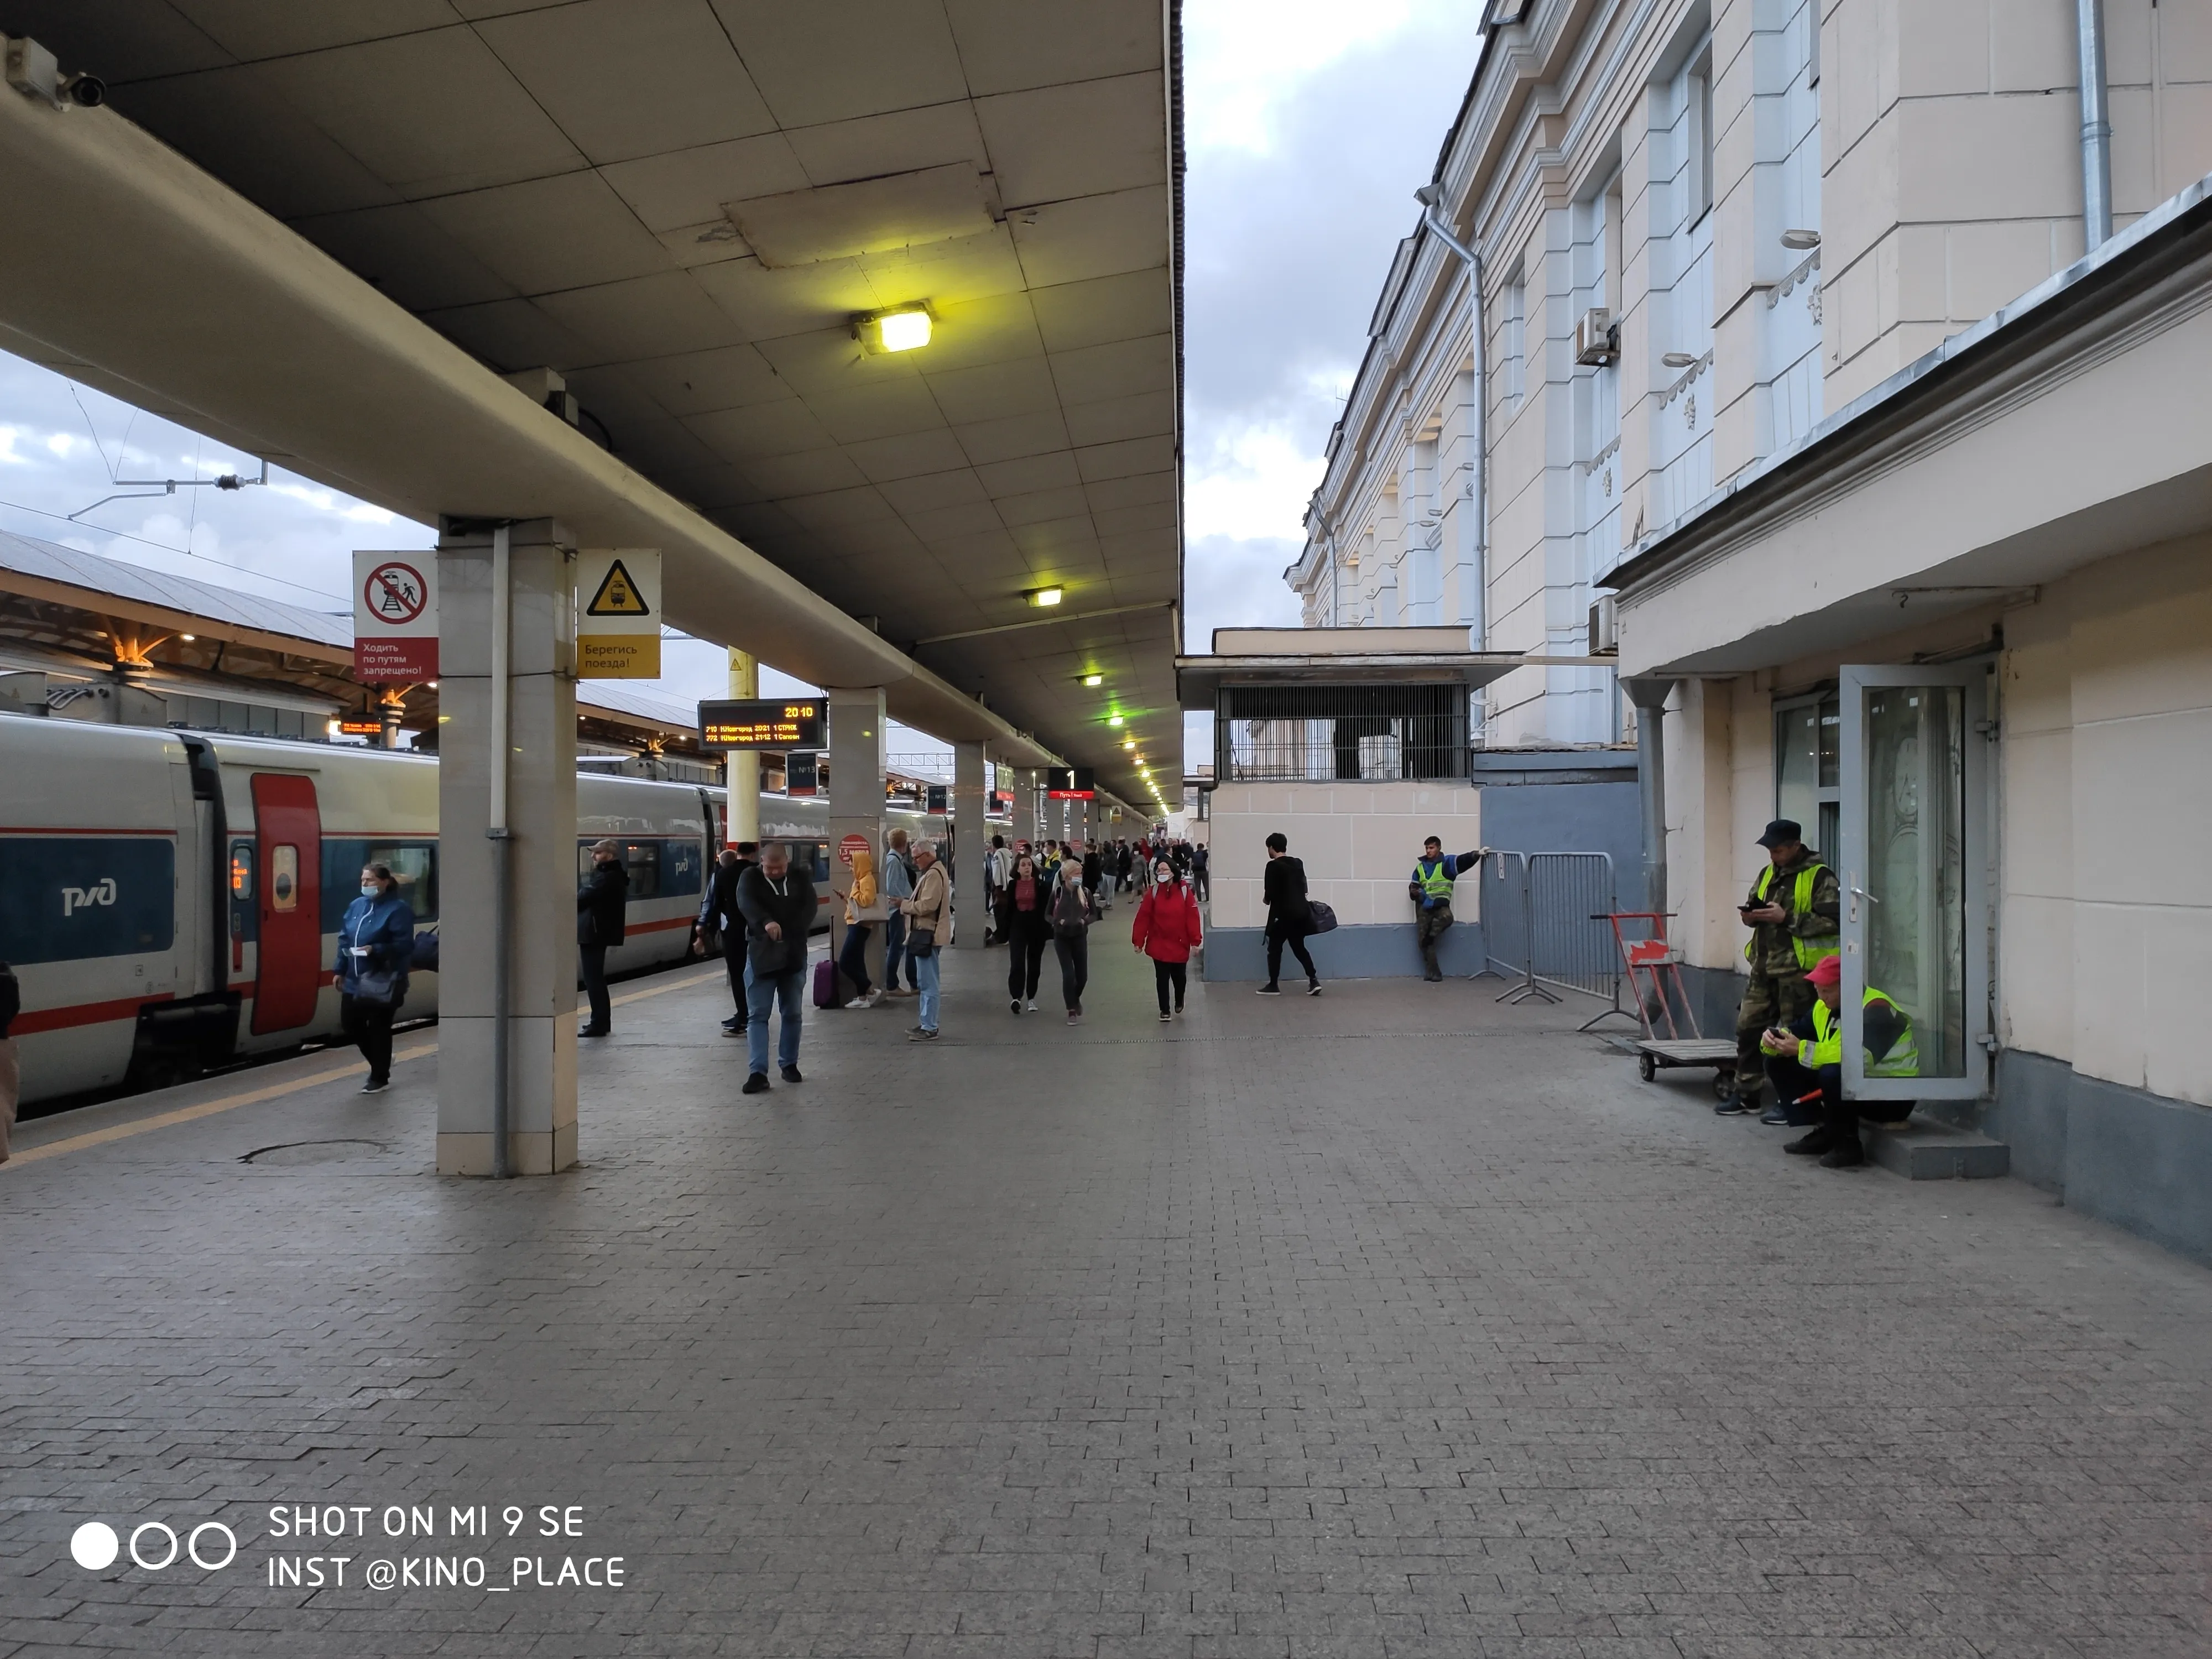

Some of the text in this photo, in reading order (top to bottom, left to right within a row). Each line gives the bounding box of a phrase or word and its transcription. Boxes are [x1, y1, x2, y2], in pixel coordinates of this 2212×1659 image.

[363, 644, 398, 653] Ходить
[585, 644, 637, 657] Берегись
[378, 656, 406, 665] путям
[585, 658, 629, 669] поезда!
[364, 666, 421, 676] запрещено!
[1067, 770, 1074, 789] 1
